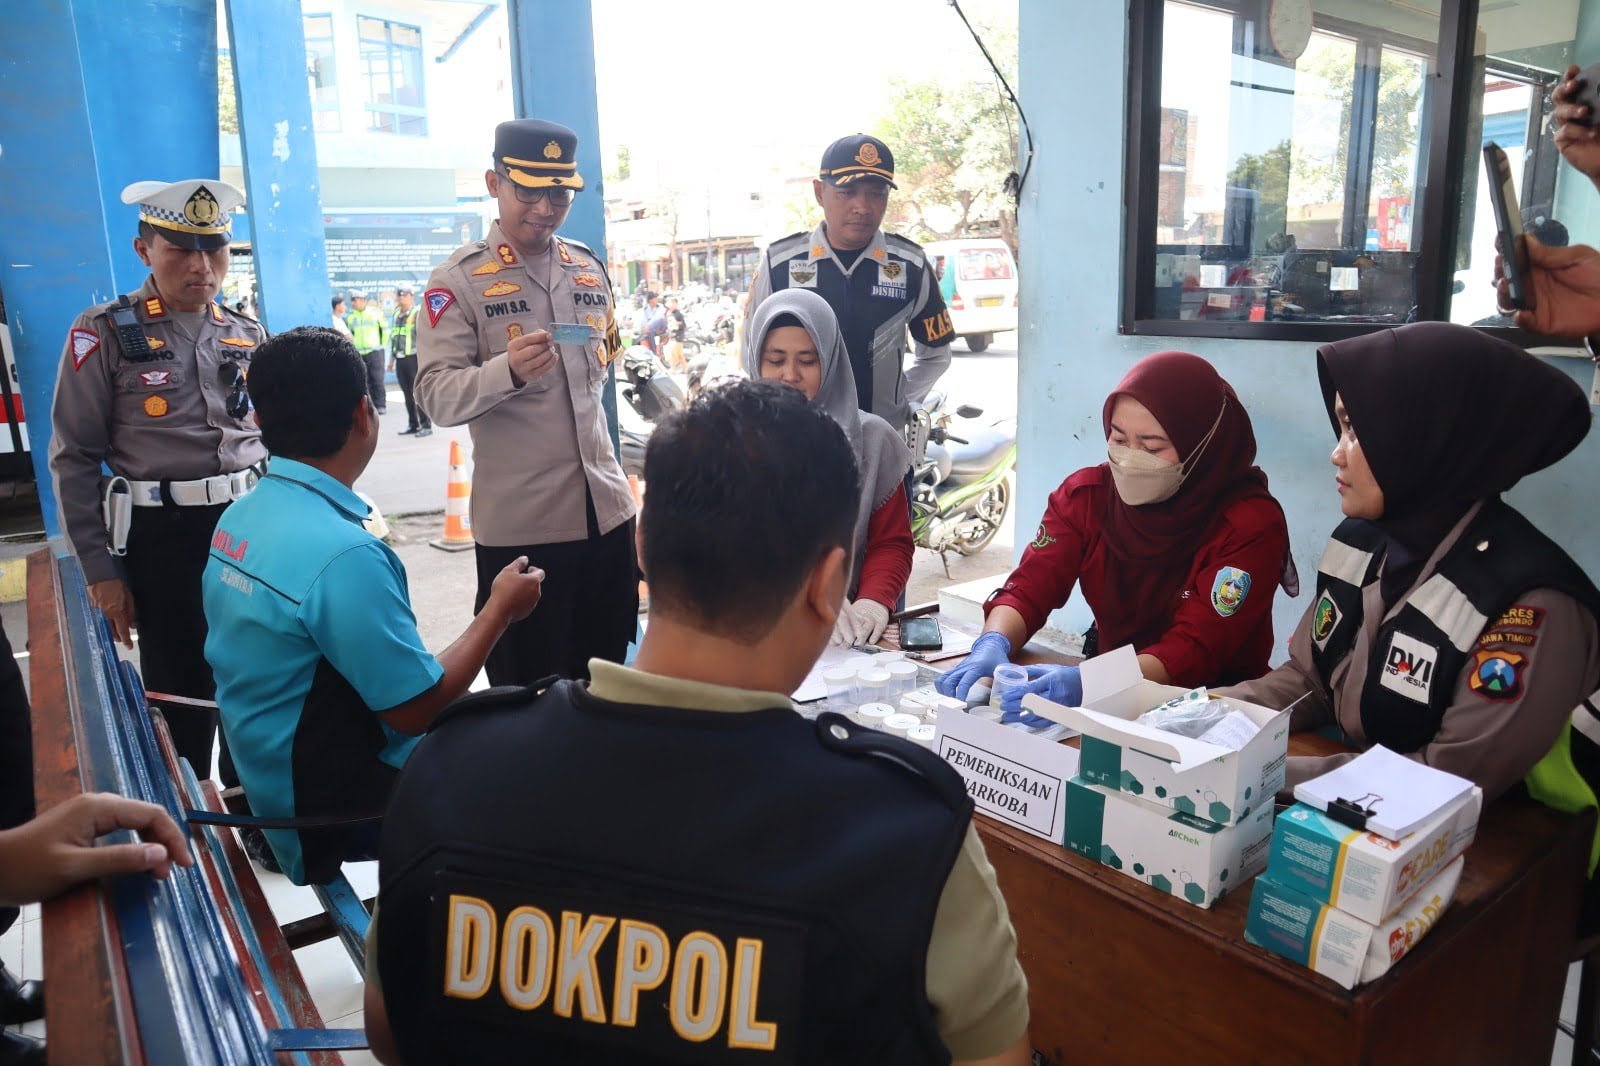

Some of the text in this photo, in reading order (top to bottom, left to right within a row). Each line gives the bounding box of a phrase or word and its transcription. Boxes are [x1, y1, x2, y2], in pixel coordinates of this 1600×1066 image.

[573, 292, 608, 307] POLRI
[872, 285, 907, 300] DISHUB
[485, 299, 531, 319] DWI S.R.
[222, 349, 254, 361] POL
[1502, 608, 1535, 619] RES
[1480, 633, 1534, 645] JAWA TIMUR
[1387, 645, 1433, 683] DVI
[945, 747, 1052, 800] PEMERIKSAAN
[444, 894, 778, 1050] DOKPOL
